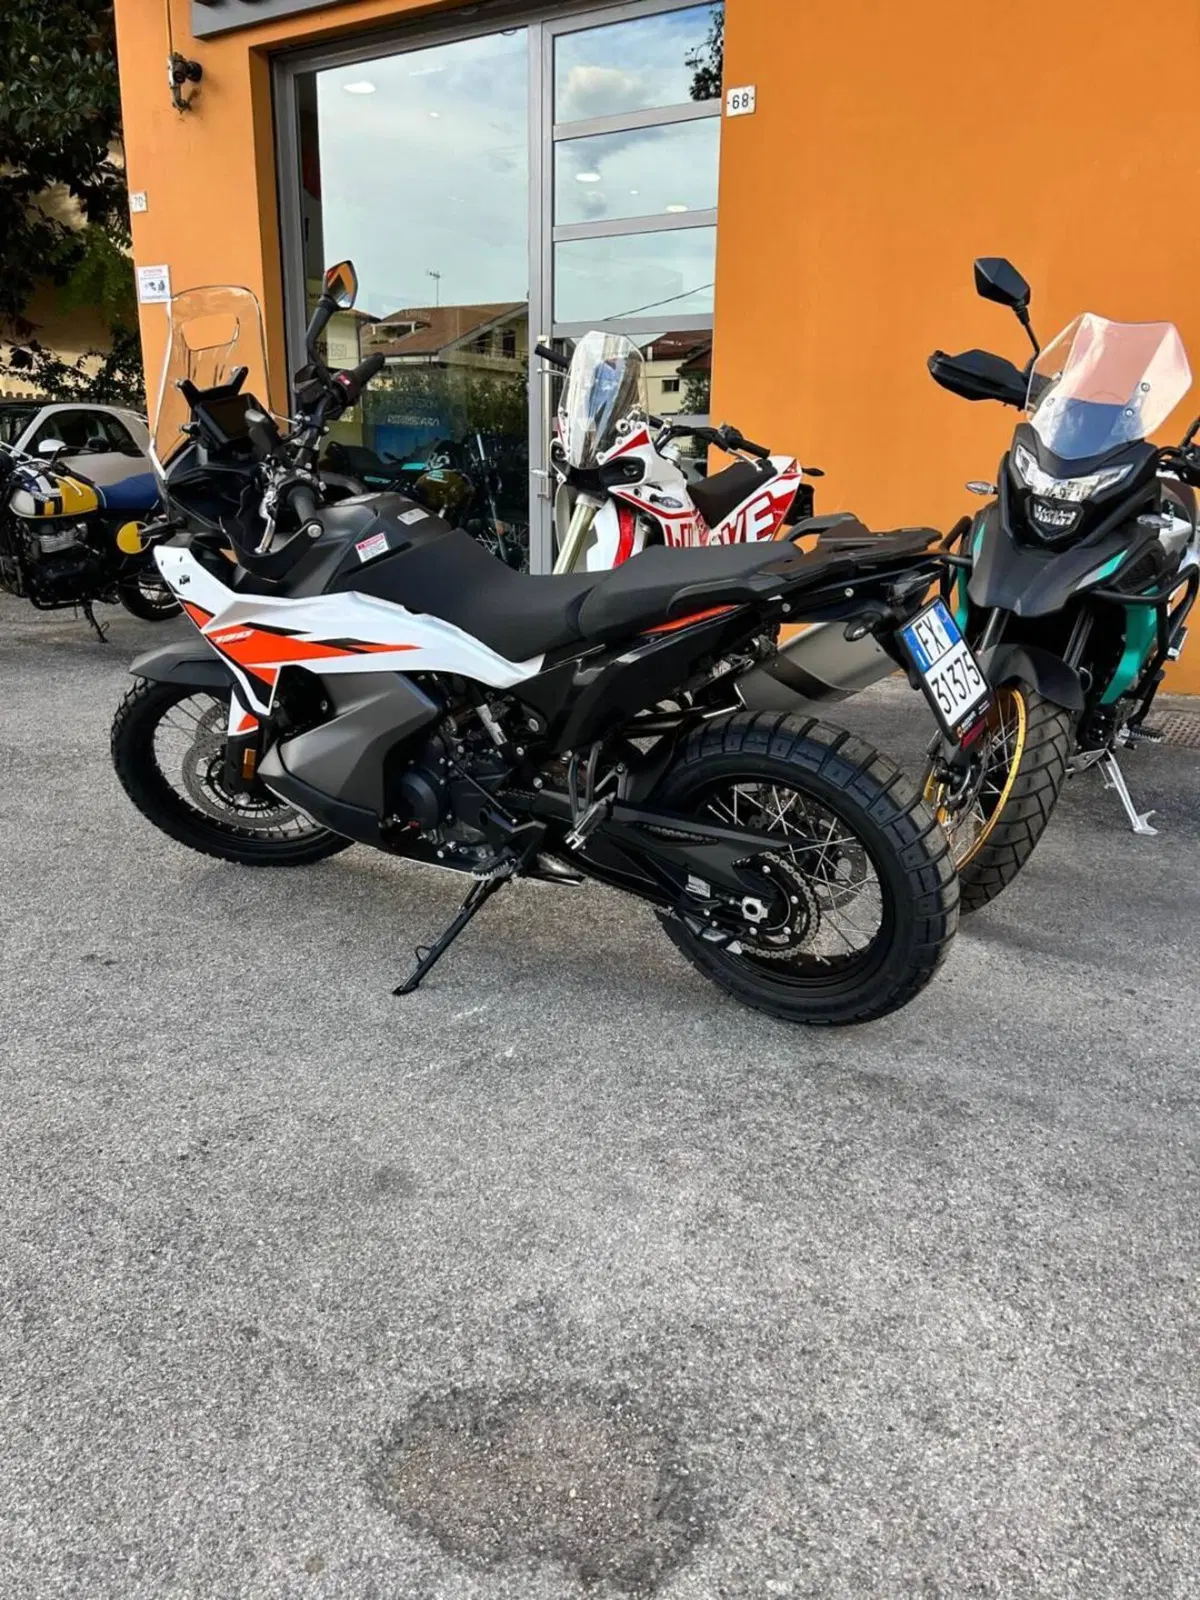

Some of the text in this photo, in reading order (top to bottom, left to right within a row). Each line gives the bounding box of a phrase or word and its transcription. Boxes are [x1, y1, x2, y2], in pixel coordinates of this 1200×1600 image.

[732, 93, 749, 109] 68
[915, 615, 946, 662] FX
[931, 651, 981, 715] 31375
